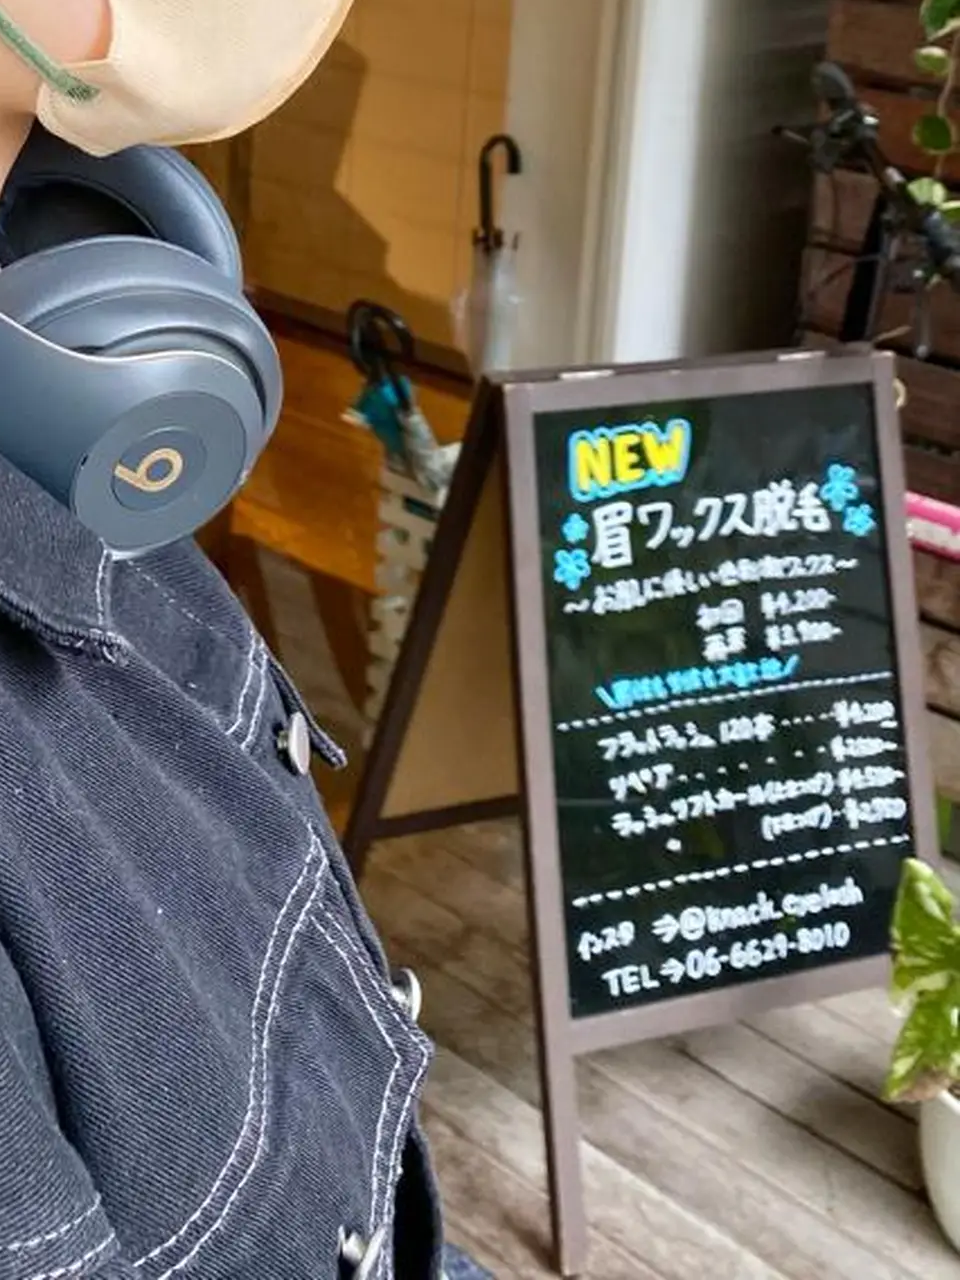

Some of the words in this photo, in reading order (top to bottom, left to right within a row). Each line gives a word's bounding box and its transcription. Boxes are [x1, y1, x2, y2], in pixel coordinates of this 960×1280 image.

[574, 424, 687, 495] NEW
[592, 479, 832, 568] 眉ワックス脱毛
[602, 964, 660, 997] TEL
